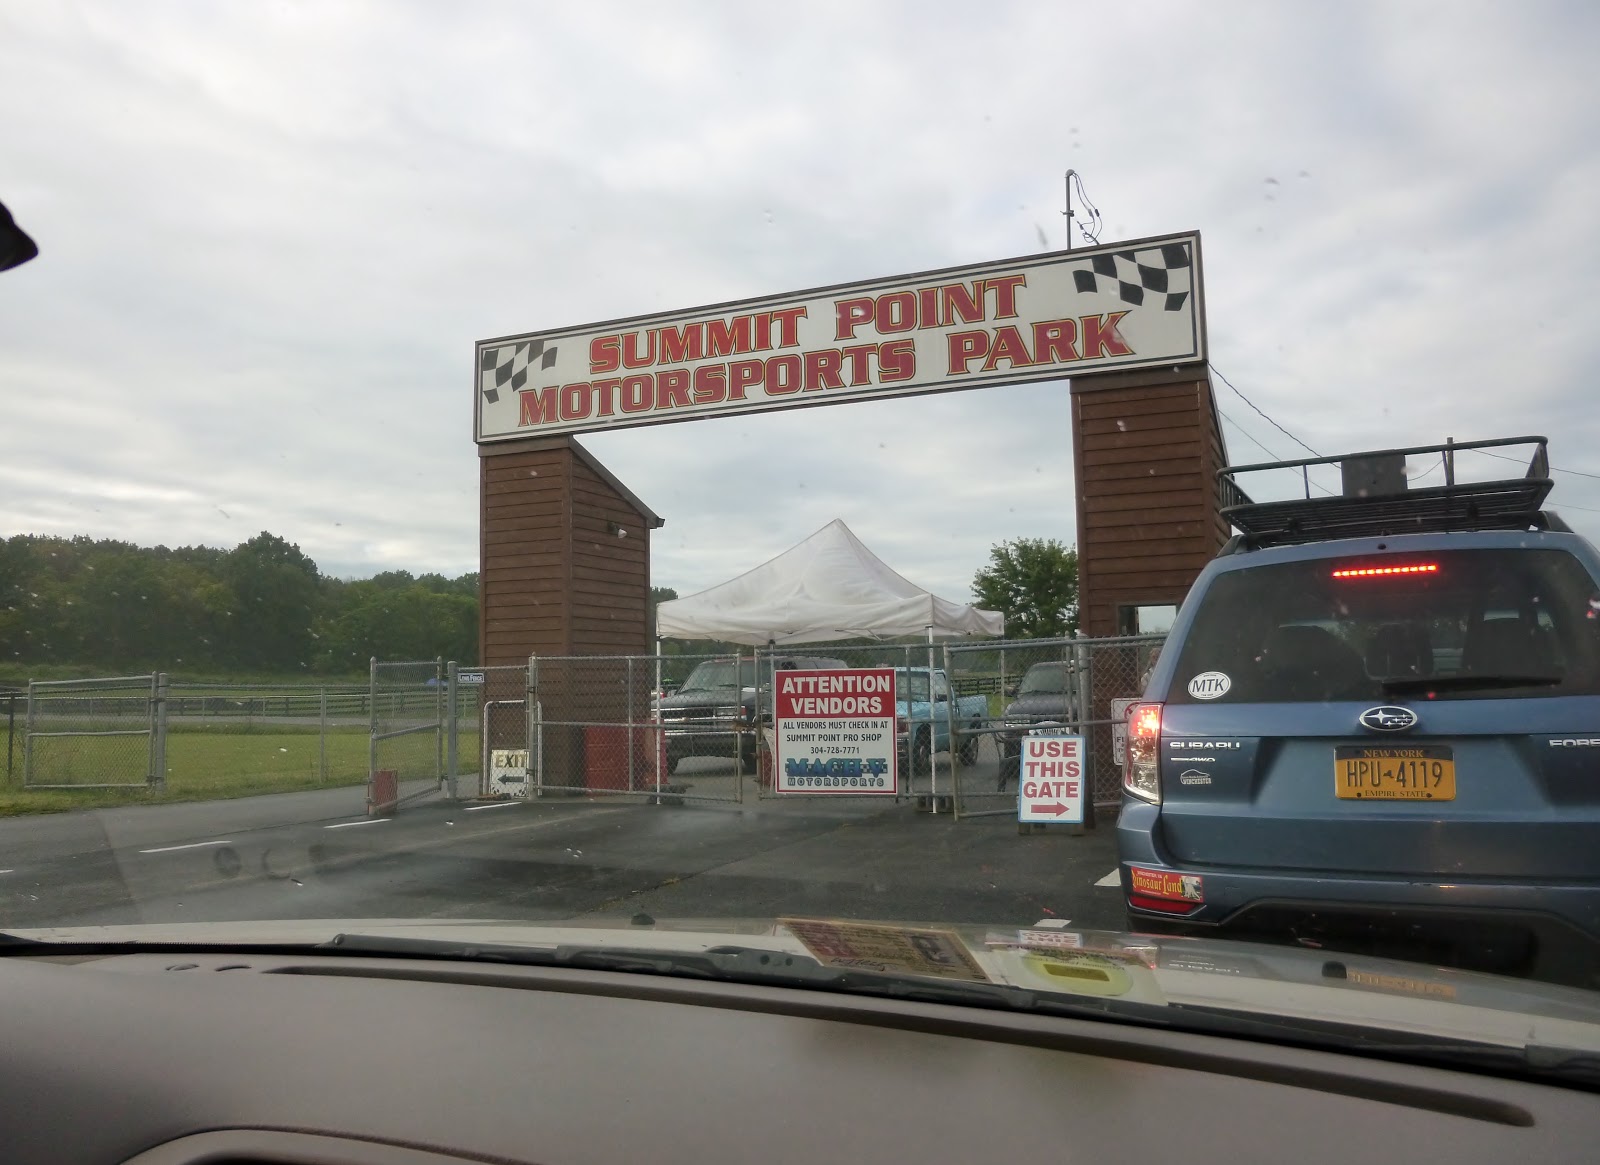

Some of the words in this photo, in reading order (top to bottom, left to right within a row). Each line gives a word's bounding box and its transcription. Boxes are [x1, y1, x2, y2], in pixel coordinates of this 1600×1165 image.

[589, 305, 808, 375] SUMMIT
[833, 273, 1027, 342] POINT
[518, 338, 916, 428] MOTORSPORTS
[946, 309, 1136, 376] PARK
[781, 675, 891, 694] ATTENTION
[1192, 678, 1225, 693] MTK
[790, 696, 882, 715] VENDORS
[782, 721, 795, 730] ALL
[796, 721, 827, 730] VENDORS
[828, 721, 846, 730] MUST
[848, 720, 869, 729] CHECK
[871, 720, 878, 729] IN
[880, 720, 889, 729] AT
[786, 733, 815, 742] SUMMIT
[818, 733, 841, 742] POINT
[843, 733, 859, 742] PRO
[861, 733, 882, 742] SHOP
[810, 746, 860, 754] 304-728-7771
[1029, 741, 1077, 758] USE
[1169, 741, 1241, 751] SUBARU
[1364, 749, 1392, 758] NEW
[1394, 749, 1424, 758] YORK
[495, 753, 527, 768] EXIT
[1025, 760, 1080, 778] THIS
[1346, 760, 1381, 788] HPU
[1395, 760, 1443, 788] 4119
[787, 777, 885, 787] MOTORSPORTS
[1023, 781, 1079, 799] GATE
[1364, 790, 1398, 798] EMPIRE
[1399, 790, 1426, 798] STATE
[1162, 874, 1183, 895] Land
